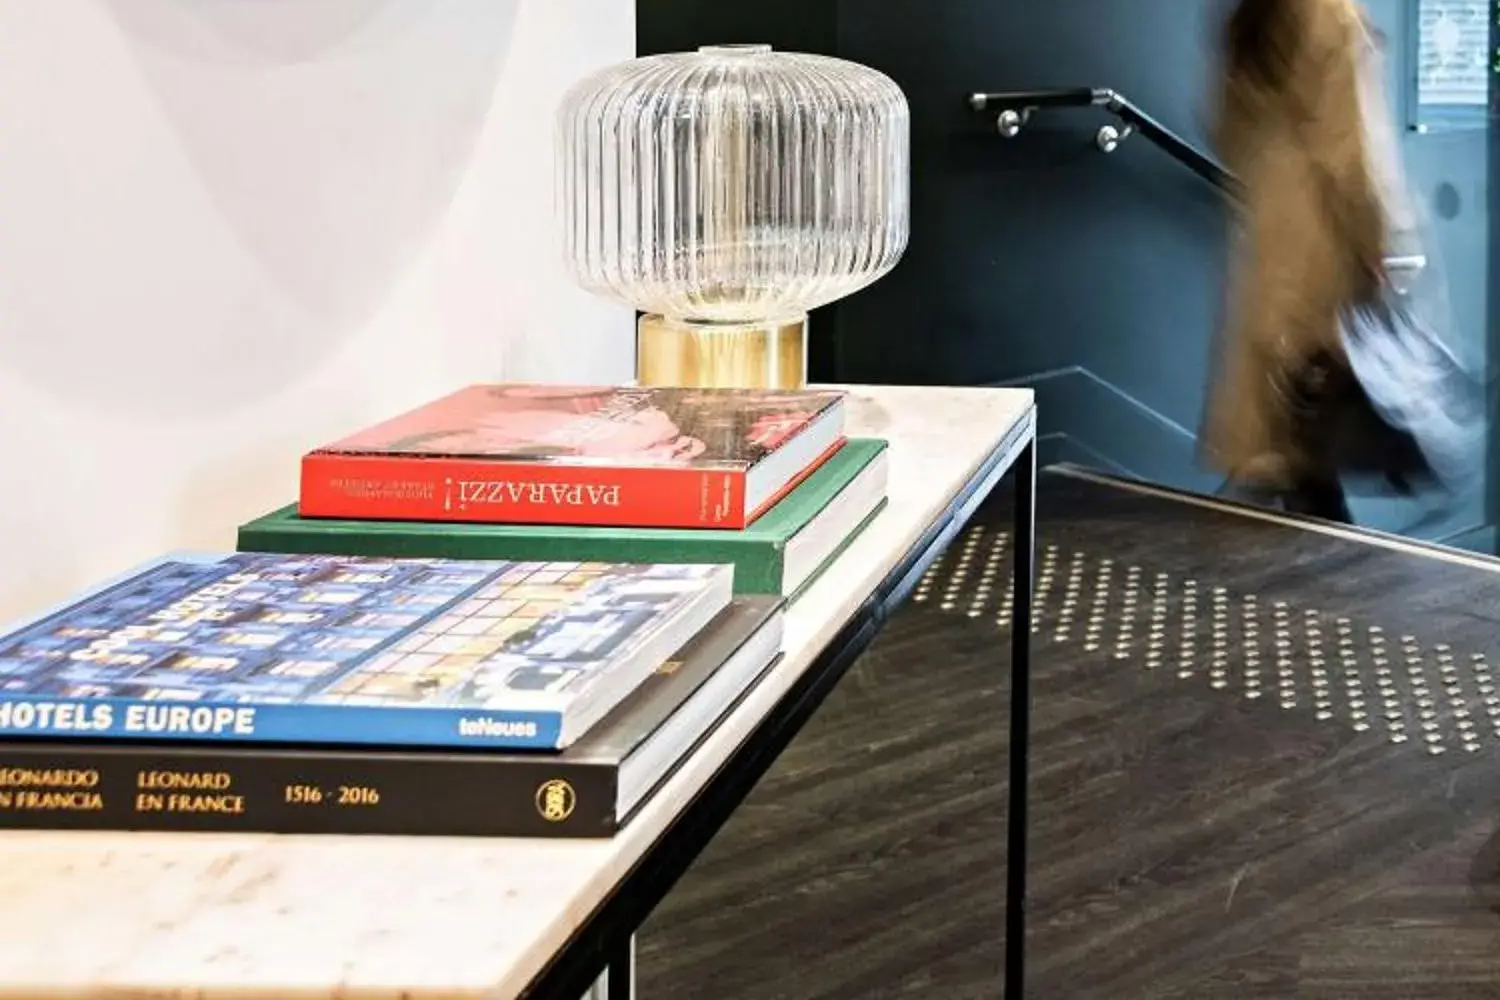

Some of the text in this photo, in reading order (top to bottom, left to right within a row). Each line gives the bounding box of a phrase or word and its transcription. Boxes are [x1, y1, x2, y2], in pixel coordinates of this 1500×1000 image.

[125, 704, 257, 734] EUROPE
[137, 770, 231, 789] LEONARD
[15, 791, 104, 809] FRANCIA
[136, 793, 245, 813] EN FRANCE
[285, 785, 322, 804] 1516
[338, 786, 379, 805] 2016
